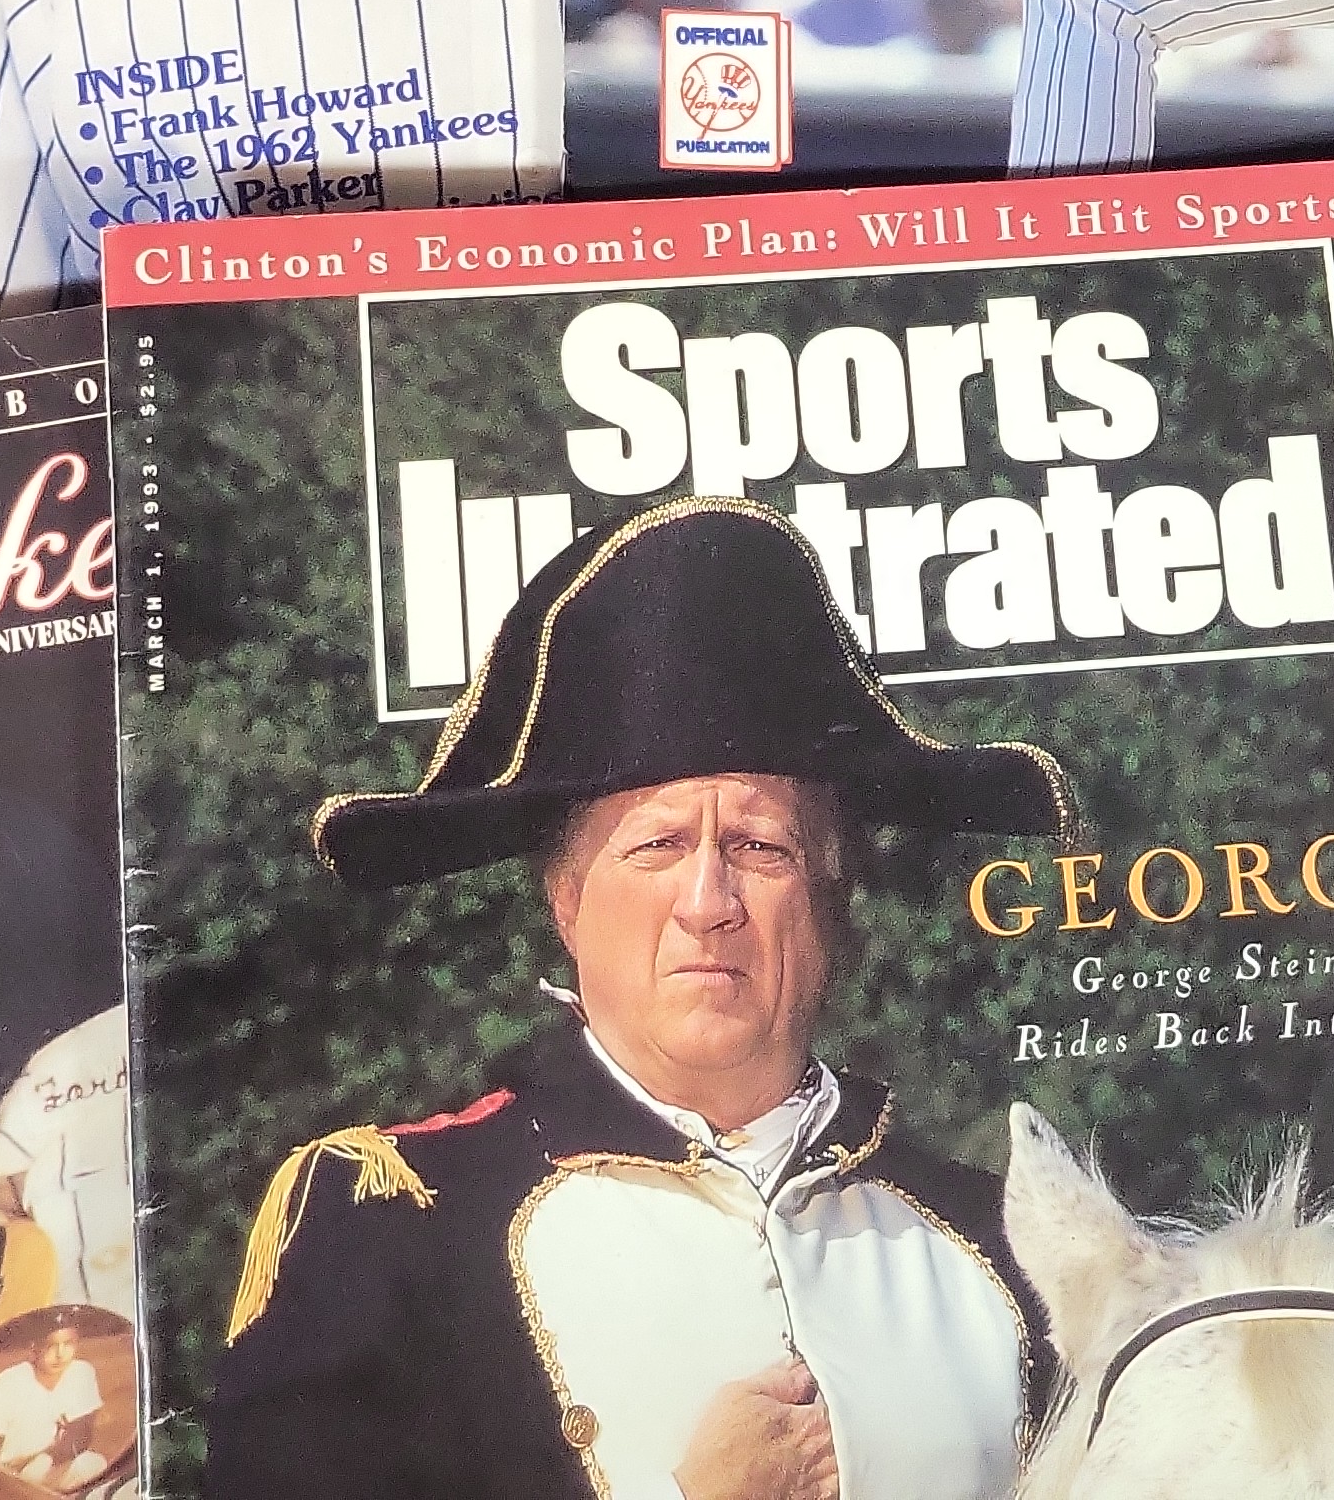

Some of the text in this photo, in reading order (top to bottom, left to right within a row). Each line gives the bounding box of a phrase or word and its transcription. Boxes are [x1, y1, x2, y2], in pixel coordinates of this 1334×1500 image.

[675, 26, 769, 46] OFFICIAL
[75, 49, 243, 105] INSIDE
[112, 68, 423, 145] Frank Howard
[116, 106, 519, 188] The 1962 Yankees
[676, 140, 771, 154] PUBLICATION
[234, 167, 379, 217] Parker
[134, 238, 389, 286] Clinton's
[416, 225, 677, 273] Economic
[702, 219, 838, 260] Plan:
[859, 209, 970, 250] Will
[995, 204, 1040, 242] It
[1065, 197, 1153, 238] Hit
[138, 335, 157, 417] $2.95
[559, 294, 1160, 500] Sports
[143, 463, 160, 532] 1993
[147, 596, 165, 692] MARCH
[1072, 956, 1212, 997] George
[1014, 1022, 1129, 1062] Rides
[1154, 1006, 1255, 1051] Back
